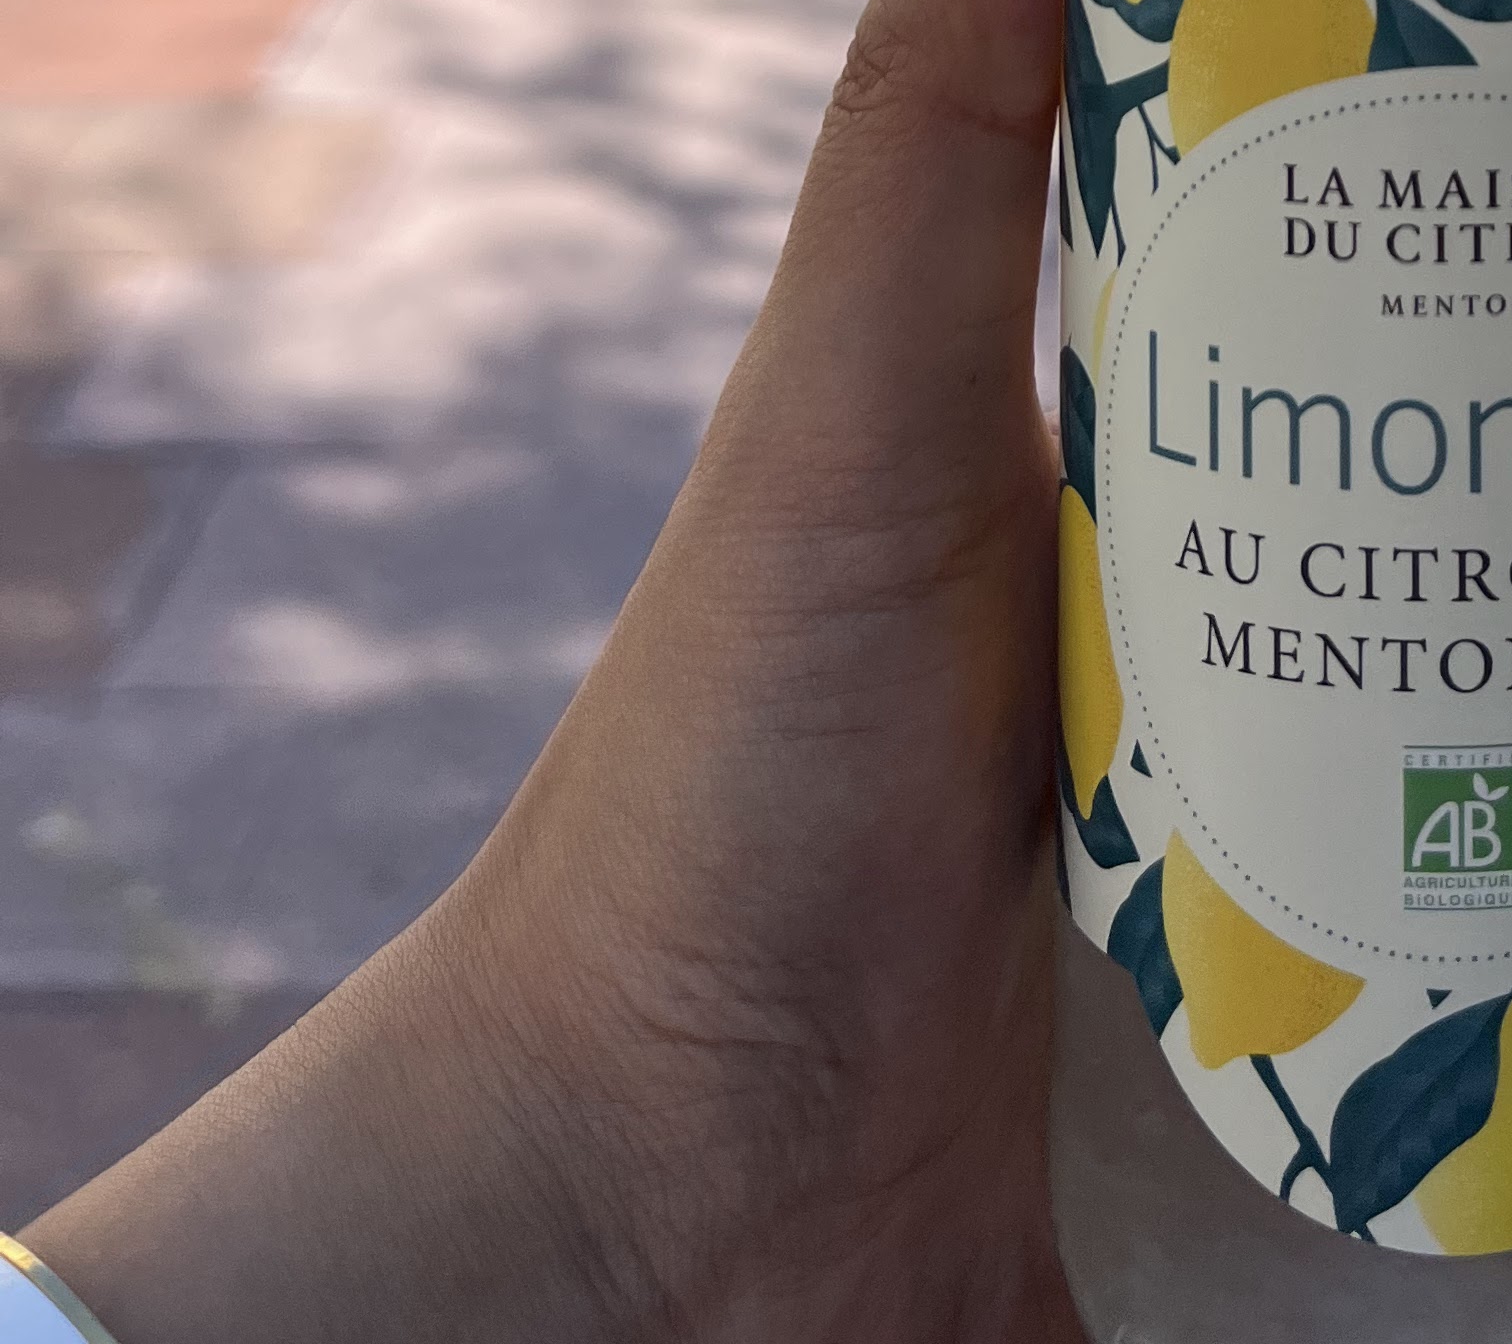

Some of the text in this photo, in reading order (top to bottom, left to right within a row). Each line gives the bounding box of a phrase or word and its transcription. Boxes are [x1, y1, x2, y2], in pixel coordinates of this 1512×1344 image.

[1283, 162, 1353, 207] LA
[1283, 217, 1361, 260] DU
[1174, 520, 1266, 585] AU
[1411, 800, 1502, 868] AB
